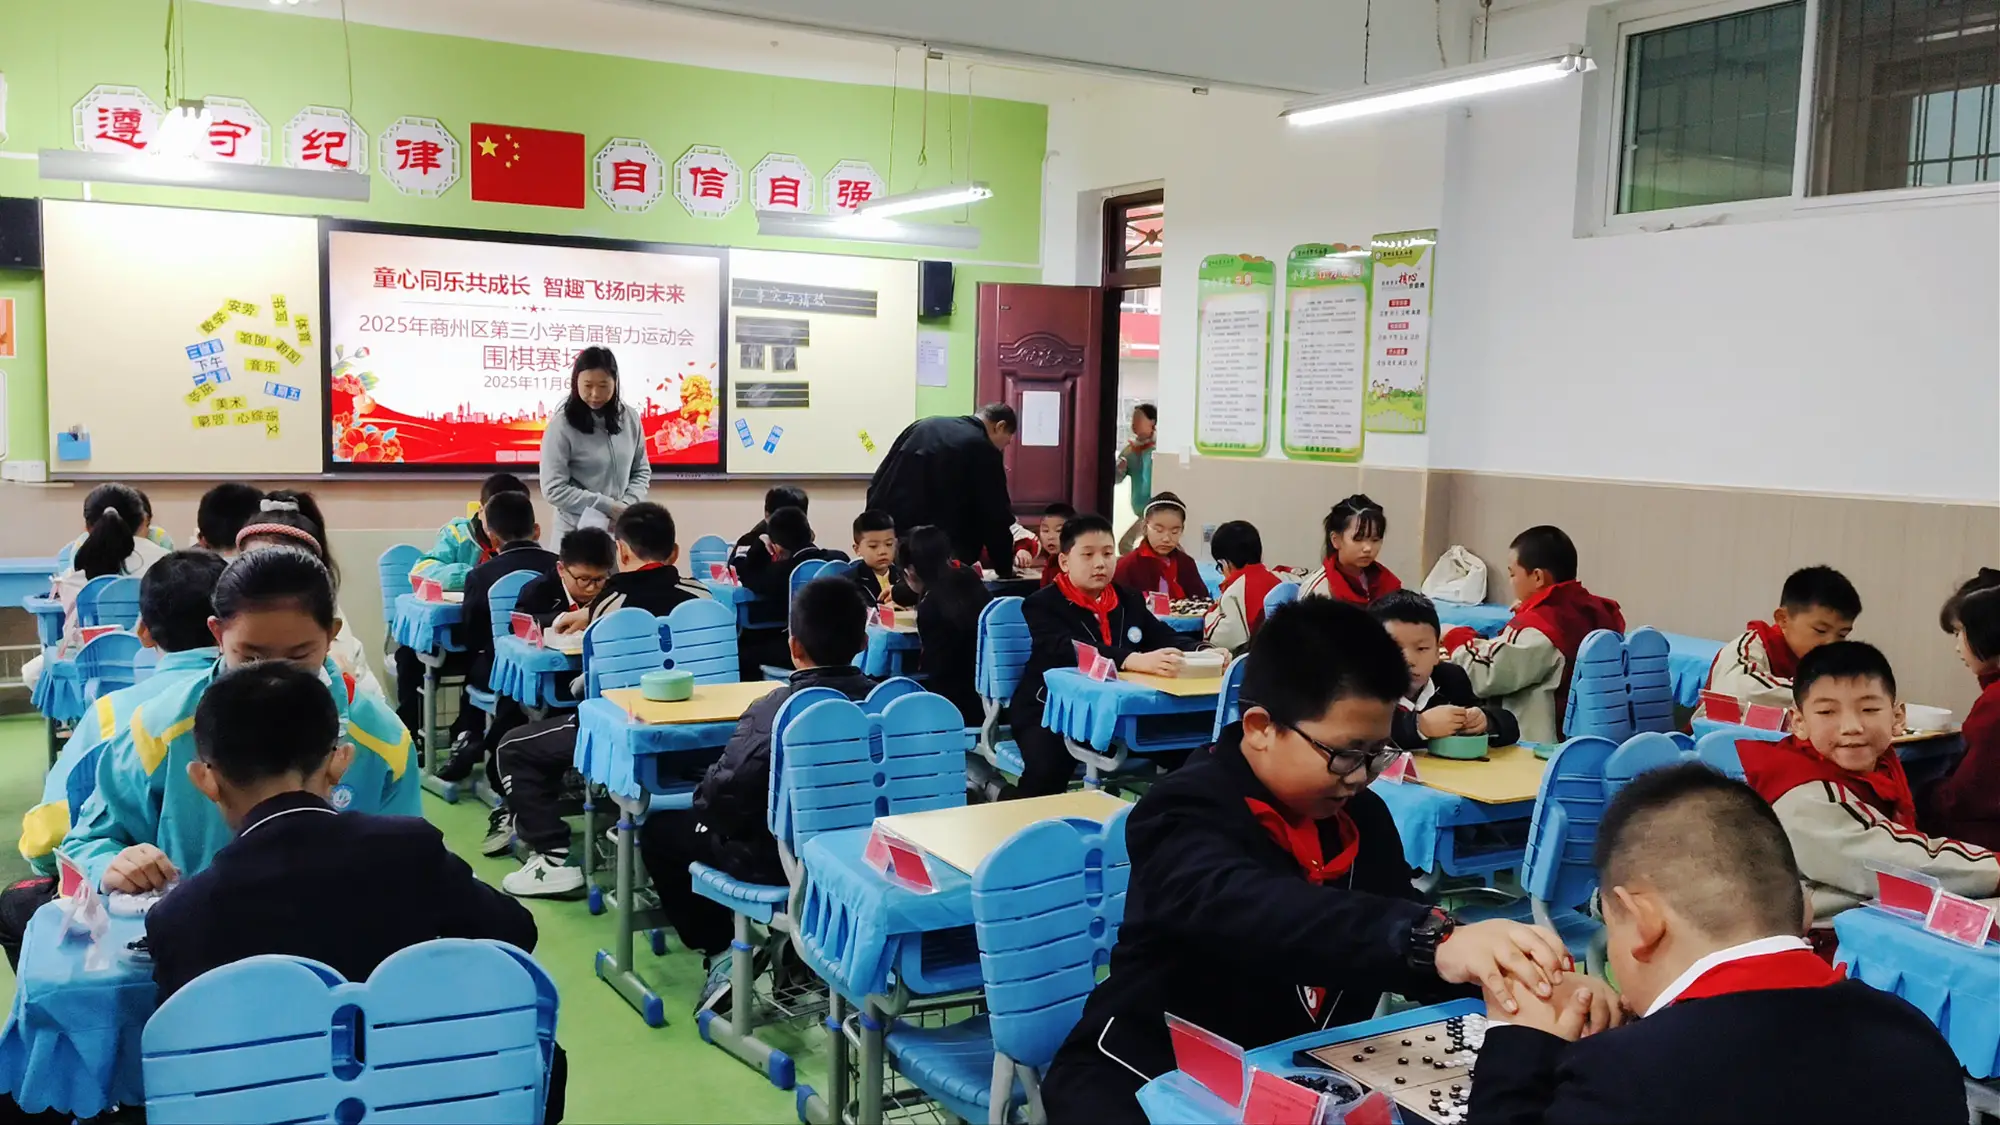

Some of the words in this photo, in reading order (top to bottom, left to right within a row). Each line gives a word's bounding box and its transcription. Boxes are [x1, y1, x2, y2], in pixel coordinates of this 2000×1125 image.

[95, 107, 444, 176] 遵守纪律
[612, 159, 872, 209] 自信自强
[373, 266, 530, 296] 童心同乐共成长
[543, 276, 685, 304] 智趣飞扬向未来
[359, 315, 694, 346] 2025年商州区第三小学首届智力运动会
[194, 355, 223, 371] 下午
[249, 359, 276, 373] 音乐
